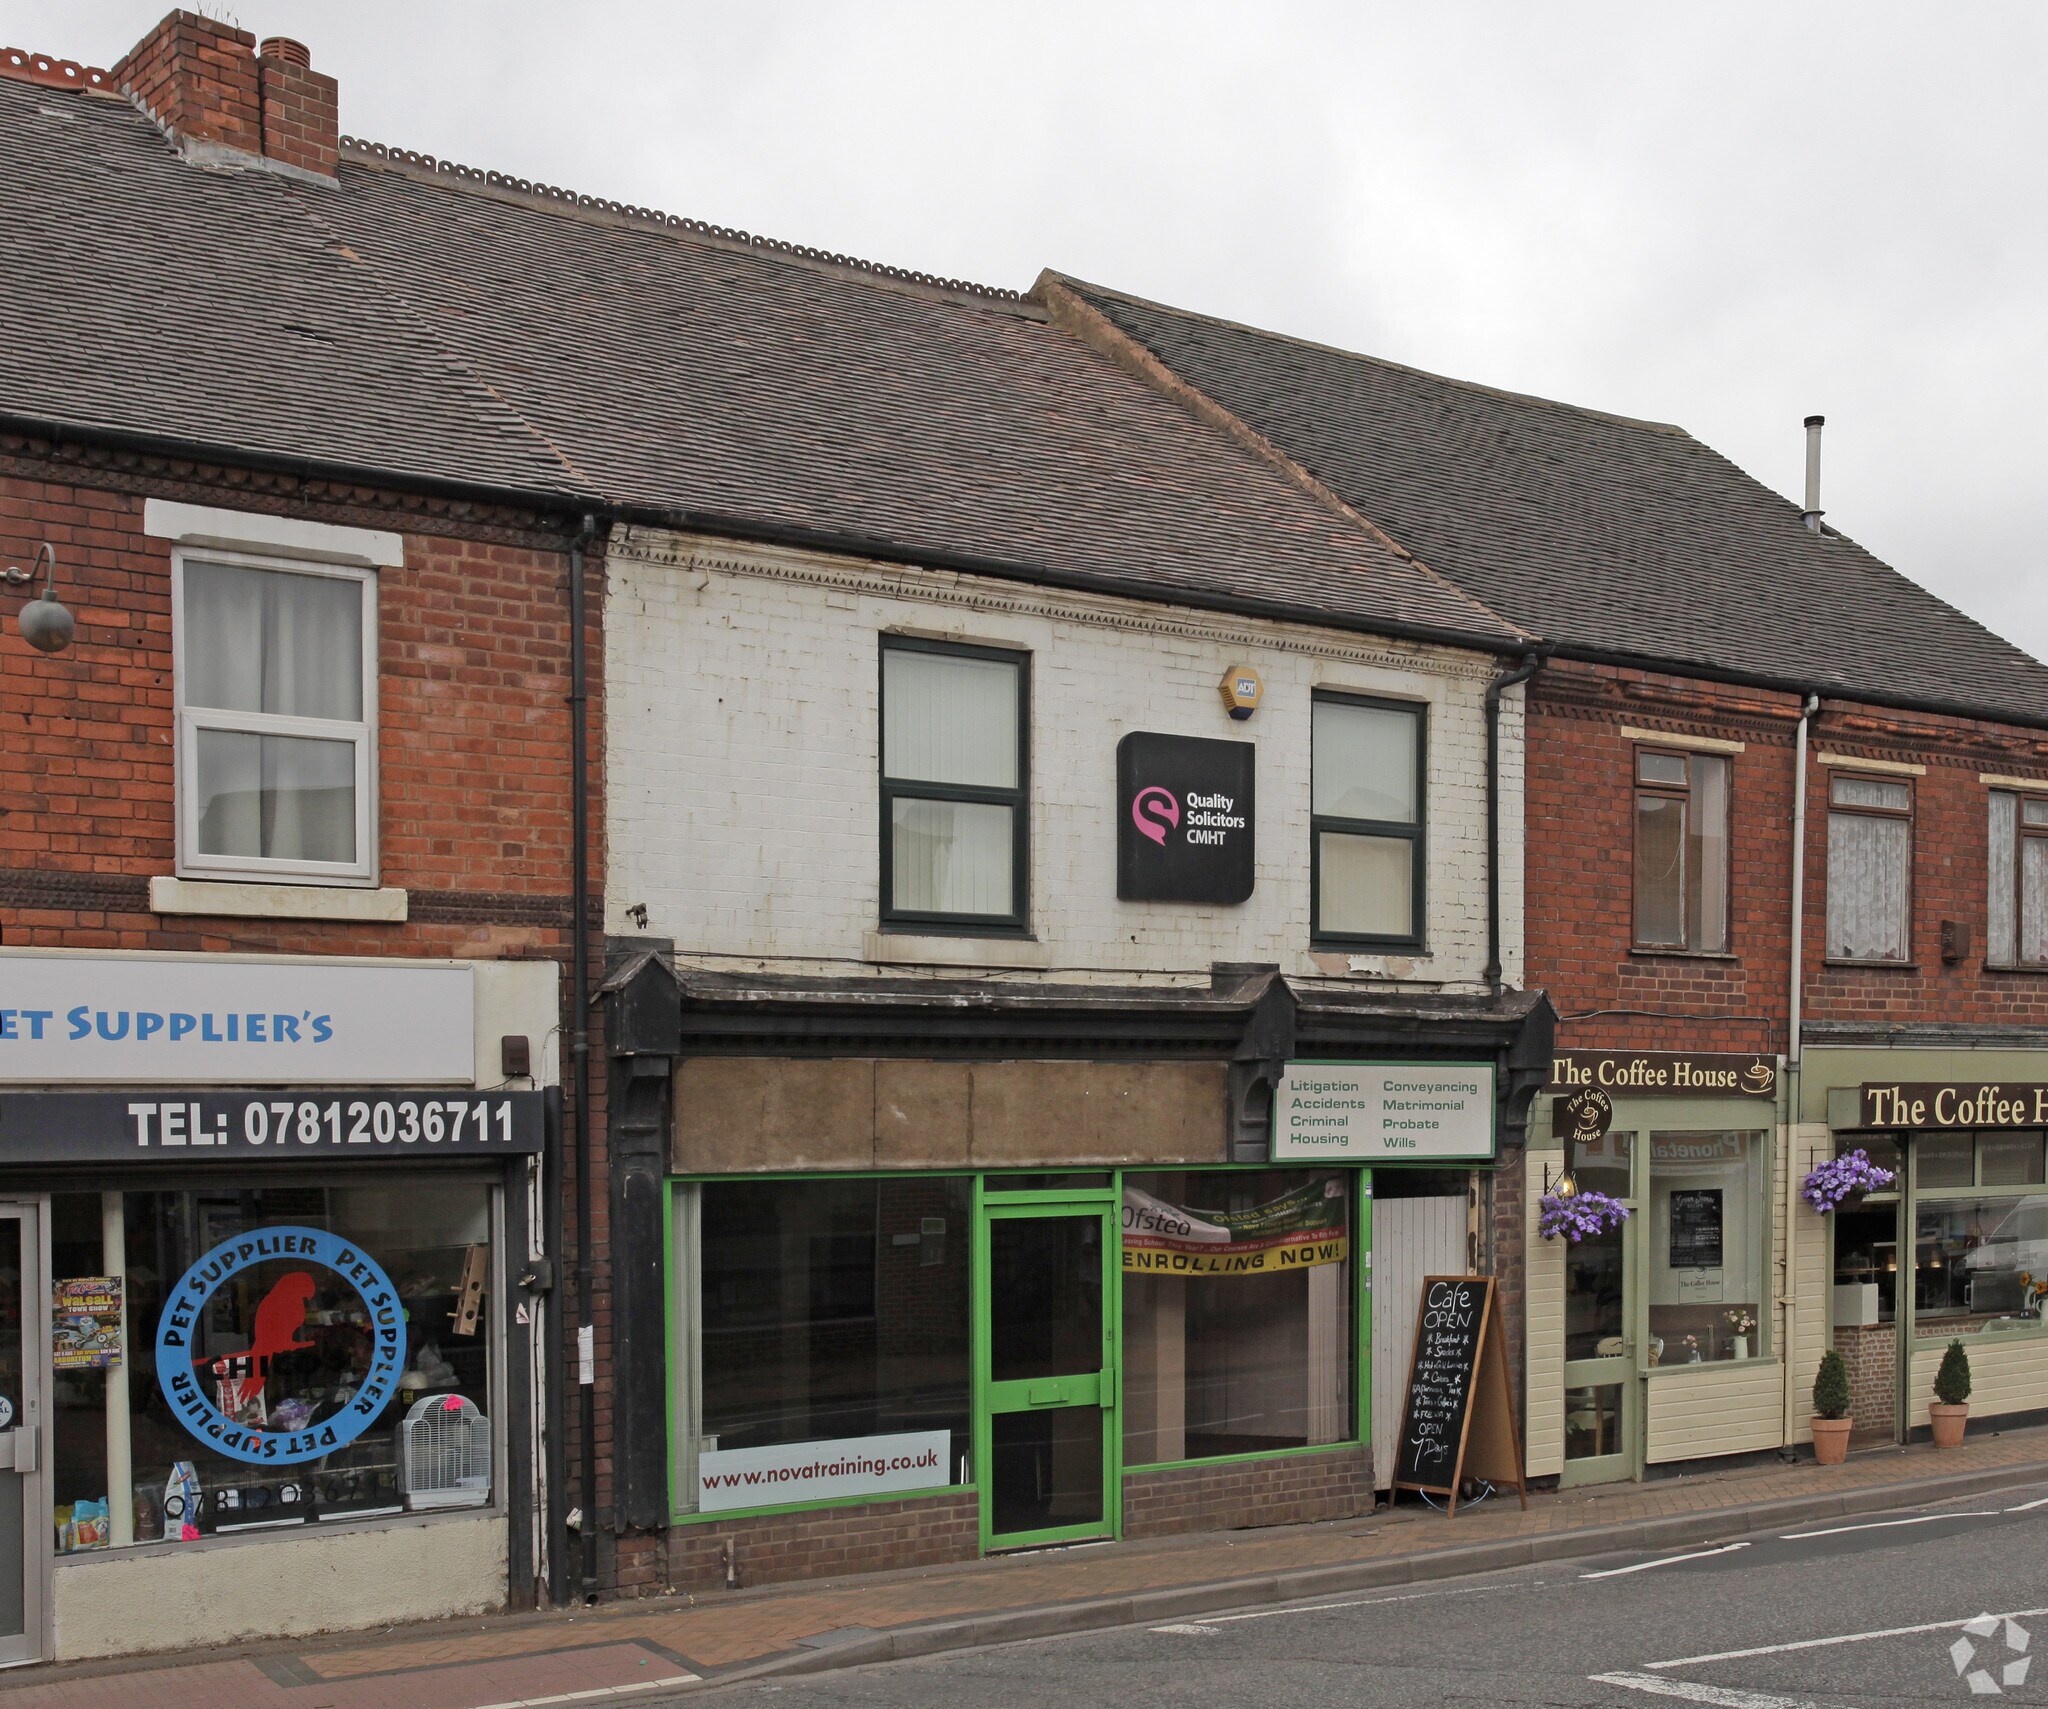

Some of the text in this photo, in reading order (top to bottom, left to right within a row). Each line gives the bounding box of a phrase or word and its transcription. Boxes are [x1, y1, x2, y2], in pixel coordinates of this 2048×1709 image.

[1237, 682, 1256, 695] ADT
[1187, 792, 1233, 812] Quality
[1187, 810, 1245, 829] Solicitors
[1187, 829, 1226, 845] CMHT
[1551, 1058, 1737, 1087] The Coffee House
[1290, 1080, 1478, 1095] Litigation Conveyancing
[1291, 1098, 1464, 1111] Accidents Matrimonial
[1567, 1089, 1609, 1113] The Coffee
[1868, 1085, 1925, 1126] The
[1935, 1086, 2025, 1125] Coffee
[128, 1100, 512, 1146] TEL: 07812036711
[1290, 1115, 1439, 1129] Criminal Probate
[1290, 1133, 1416, 1148] Housing Wills
[1573, 1128, 1601, 1141] House
[1122, 1206, 1191, 1236] Ofsted
[1213, 1210, 1260, 1223] Ofsted
[1143, 1239, 1165, 1247] School
[1122, 1243, 1340, 1272] ENROLLING NOW!
[1428, 1281, 1471, 1313] Cafe
[1424, 1311, 1473, 1328] OPEN
[163, 1235, 397, 1458] PET SUPPLIER PET SUPPLIER PET SUPPLIER
[1418, 1422, 1443, 1435] OPEN
[702, 1448, 938, 1490] www.novatraining.co.uk
